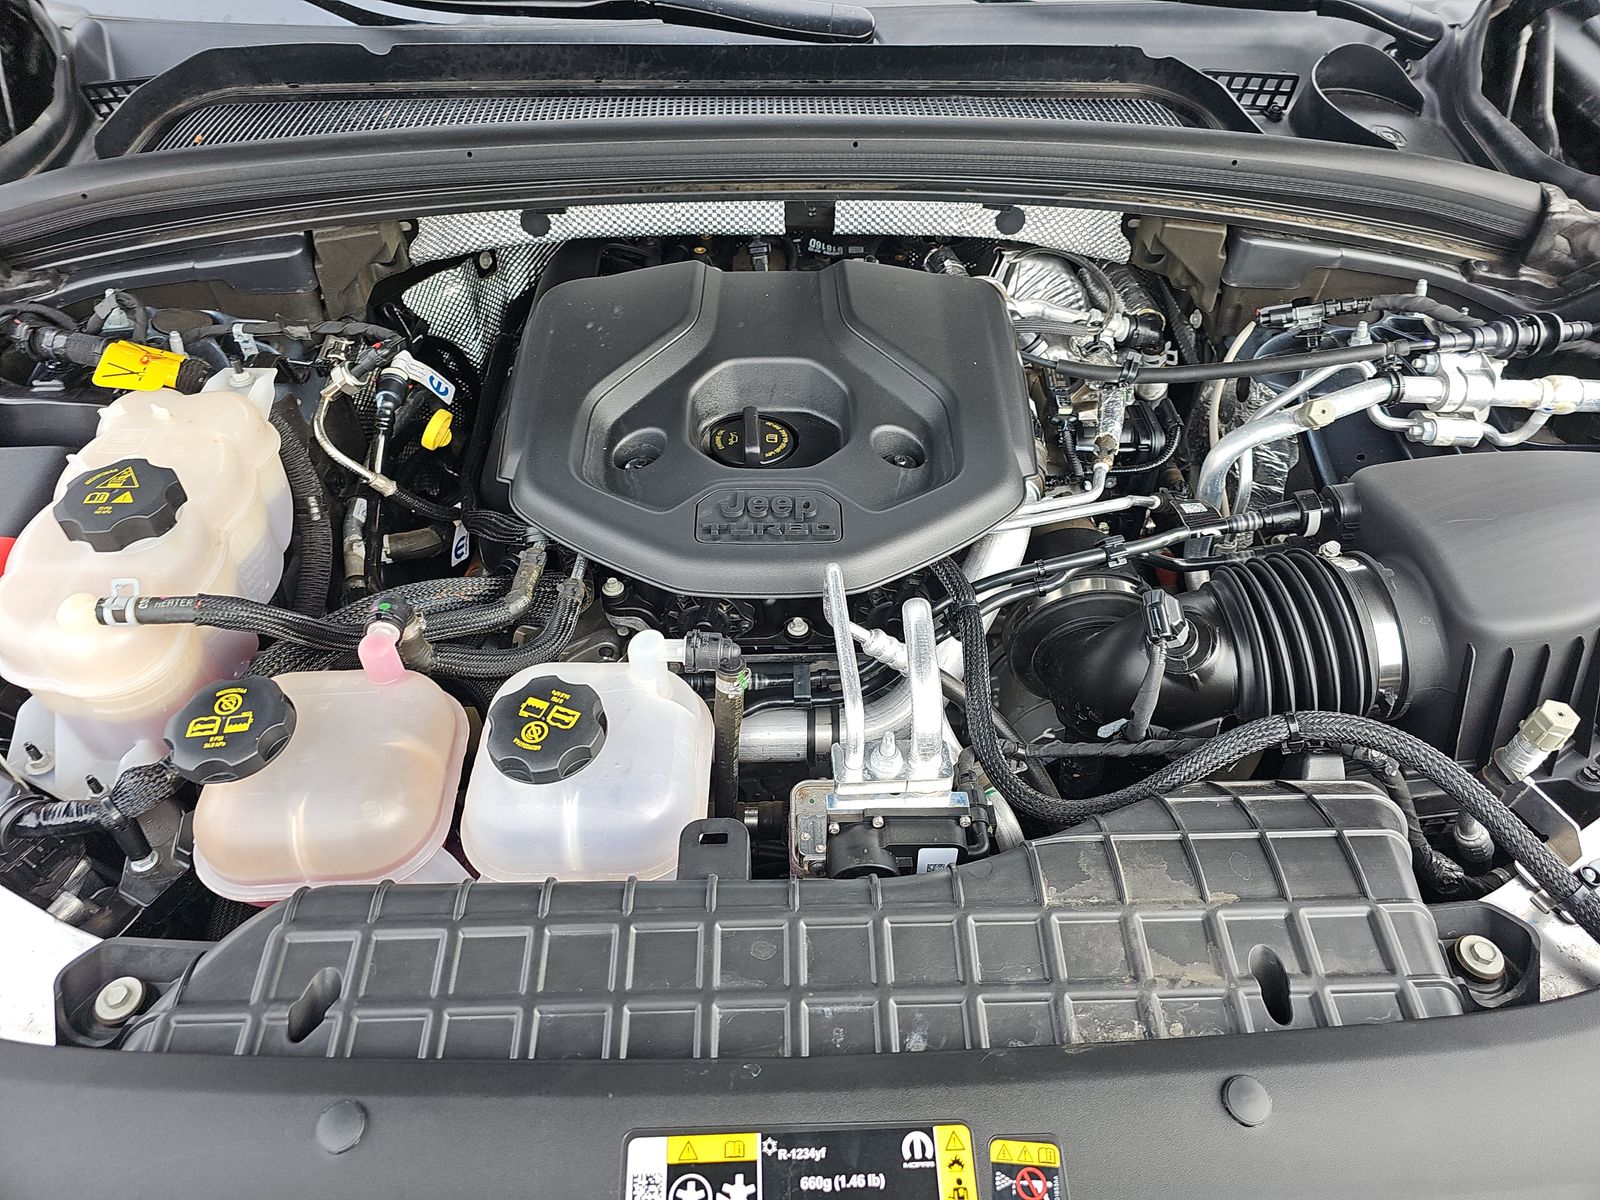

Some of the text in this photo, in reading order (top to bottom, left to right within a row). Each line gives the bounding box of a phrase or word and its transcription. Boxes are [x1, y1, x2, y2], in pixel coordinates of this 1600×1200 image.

[720, 491, 817, 522] Jeep
[702, 523, 837, 538] TURBO
[777, 1147, 826, 1161] R-1234yf
[799, 1173, 886, 1192] 660g (1.46 lb)
